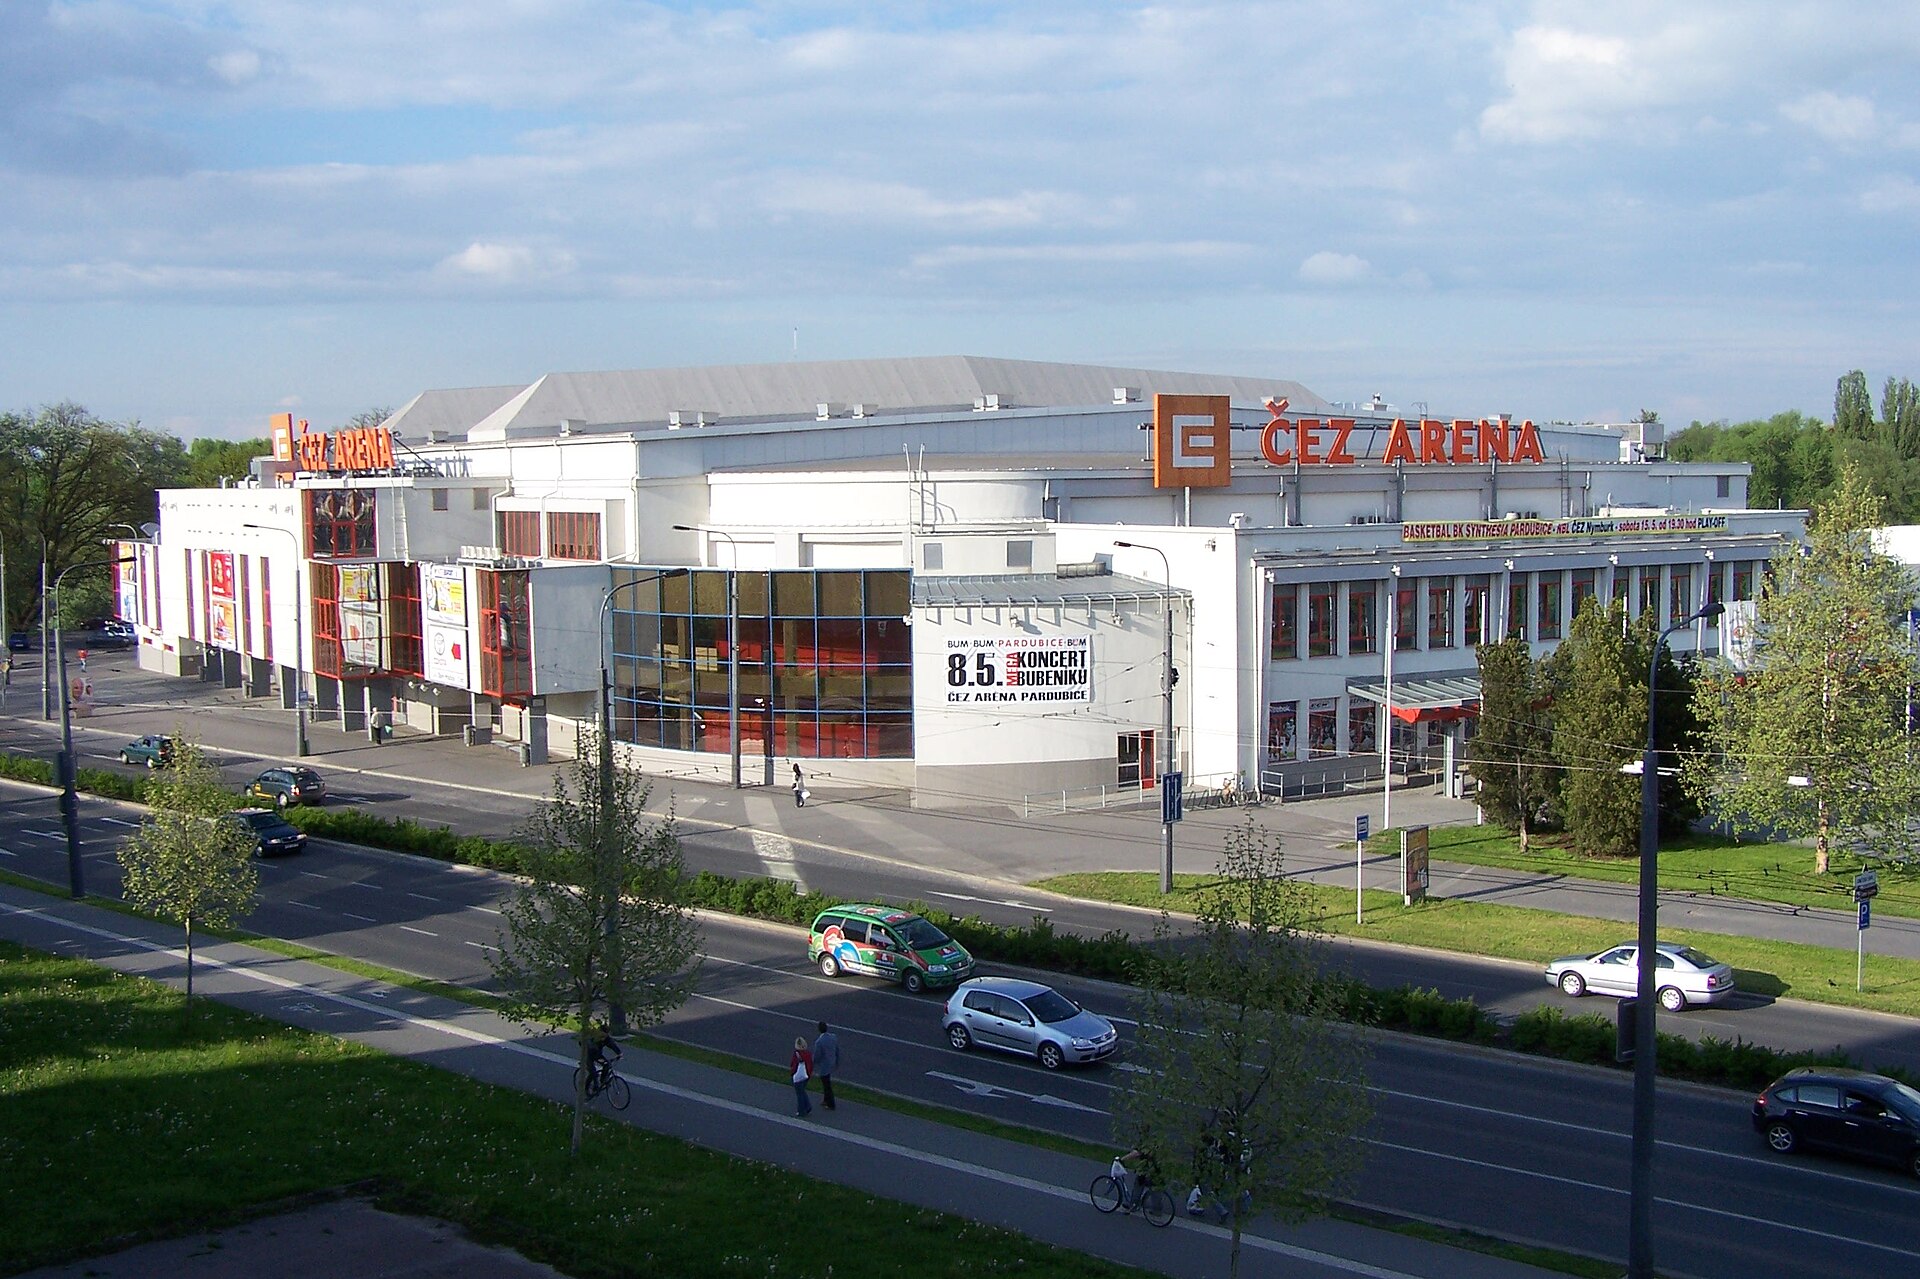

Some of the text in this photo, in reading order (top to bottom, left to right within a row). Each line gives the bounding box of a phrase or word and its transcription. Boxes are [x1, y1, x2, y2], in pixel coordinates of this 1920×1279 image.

[299, 419, 396, 471] ČEZ ARENA
[1259, 399, 1544, 466] ČEZ ARENA
[1403, 523, 1451, 539] BASKETBAL
[1453, 523, 1464, 537] BK
[1465, 522, 1509, 538] SYNTHESIA
[1509, 522, 1553, 537] PARDUBICE
[1571, 519, 1586, 534] ČEZ
[1586, 520, 1614, 536] Nymburk
[1619, 519, 1640, 532] sobota
[1659, 518, 1667, 531] od
[1685, 517, 1697, 530] hod
[1697, 516, 1726, 529] PLAY-OFF
[947, 638, 1087, 648] BUM BUM PARDUBICE BUM
[947, 652, 1004, 687] 8.5.
[1005, 651, 1019, 686] MEGA
[1018, 650, 1087, 669] KONCERT
[947, 691, 971, 702] ČEZ
[1020, 690, 1088, 702] PARDUBICE
